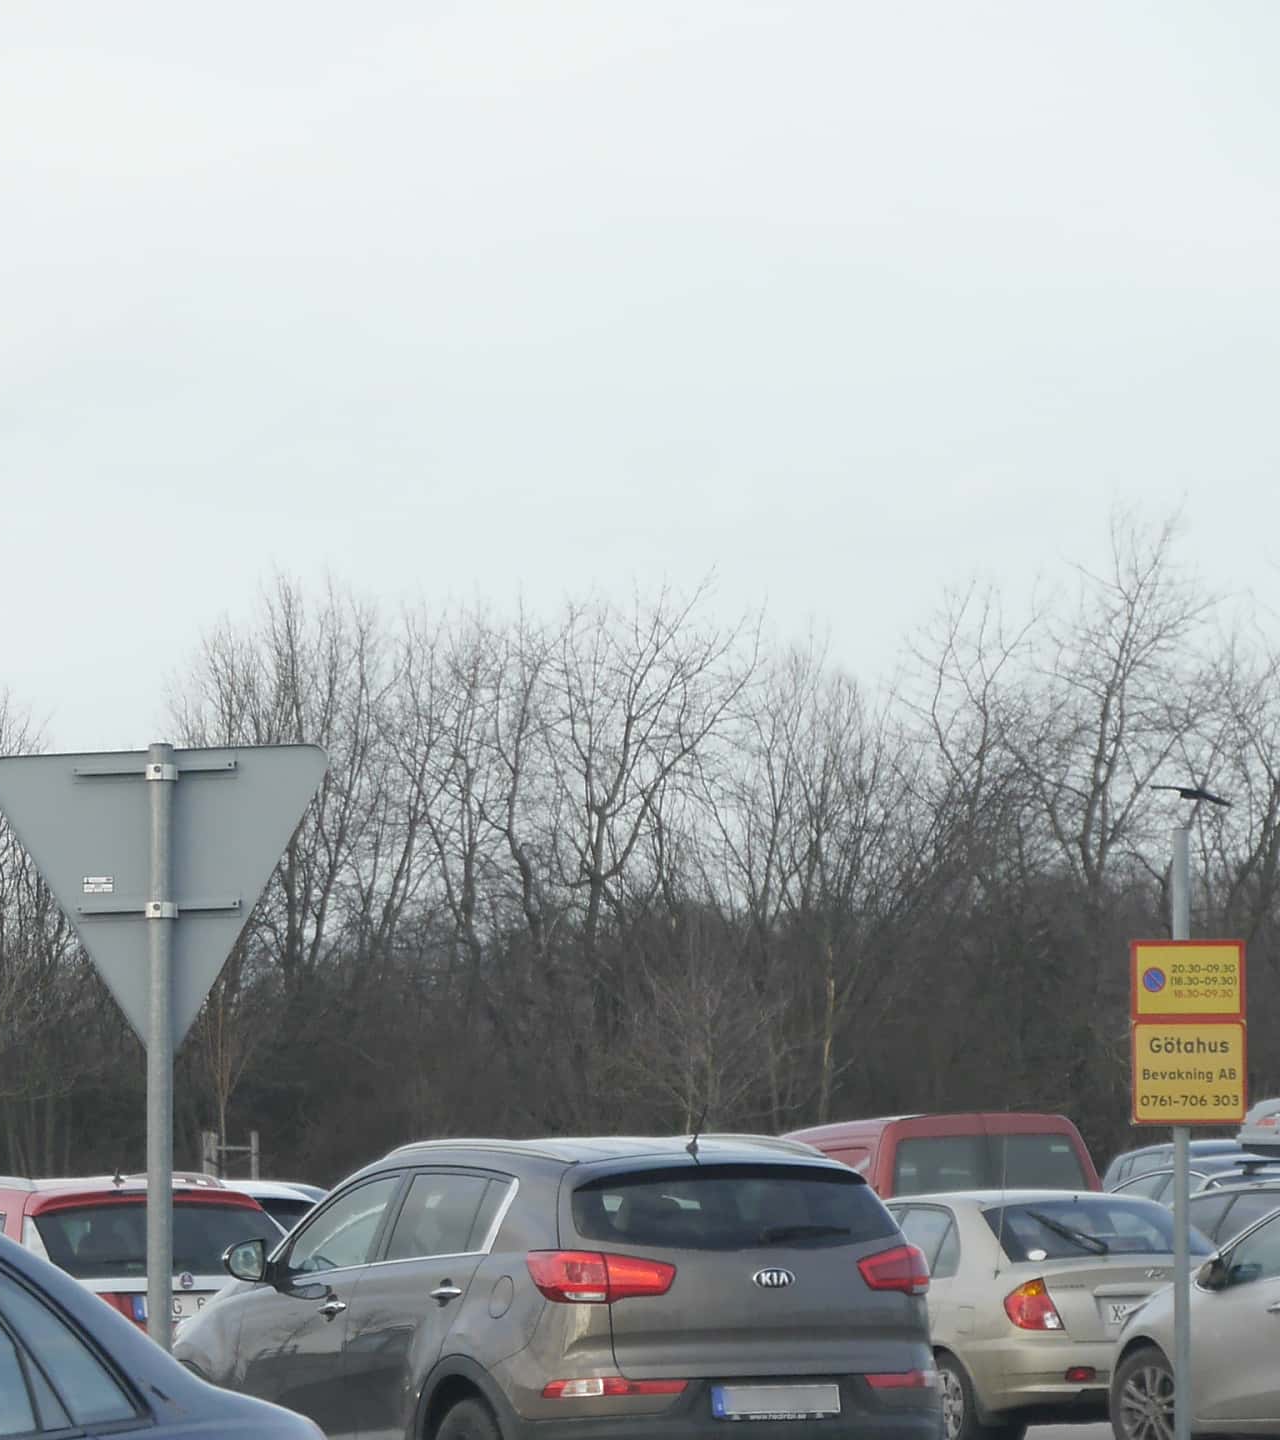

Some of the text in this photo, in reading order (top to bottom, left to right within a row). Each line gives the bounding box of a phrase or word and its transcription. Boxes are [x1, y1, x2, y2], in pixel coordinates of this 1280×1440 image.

[1149, 1036, 1230, 1054] Götahus
[1142, 1067, 1237, 1083] Bevakning AB
[1140, 1094, 1240, 1107] 0761-706 303
[760, 1271, 789, 1286] KIA
